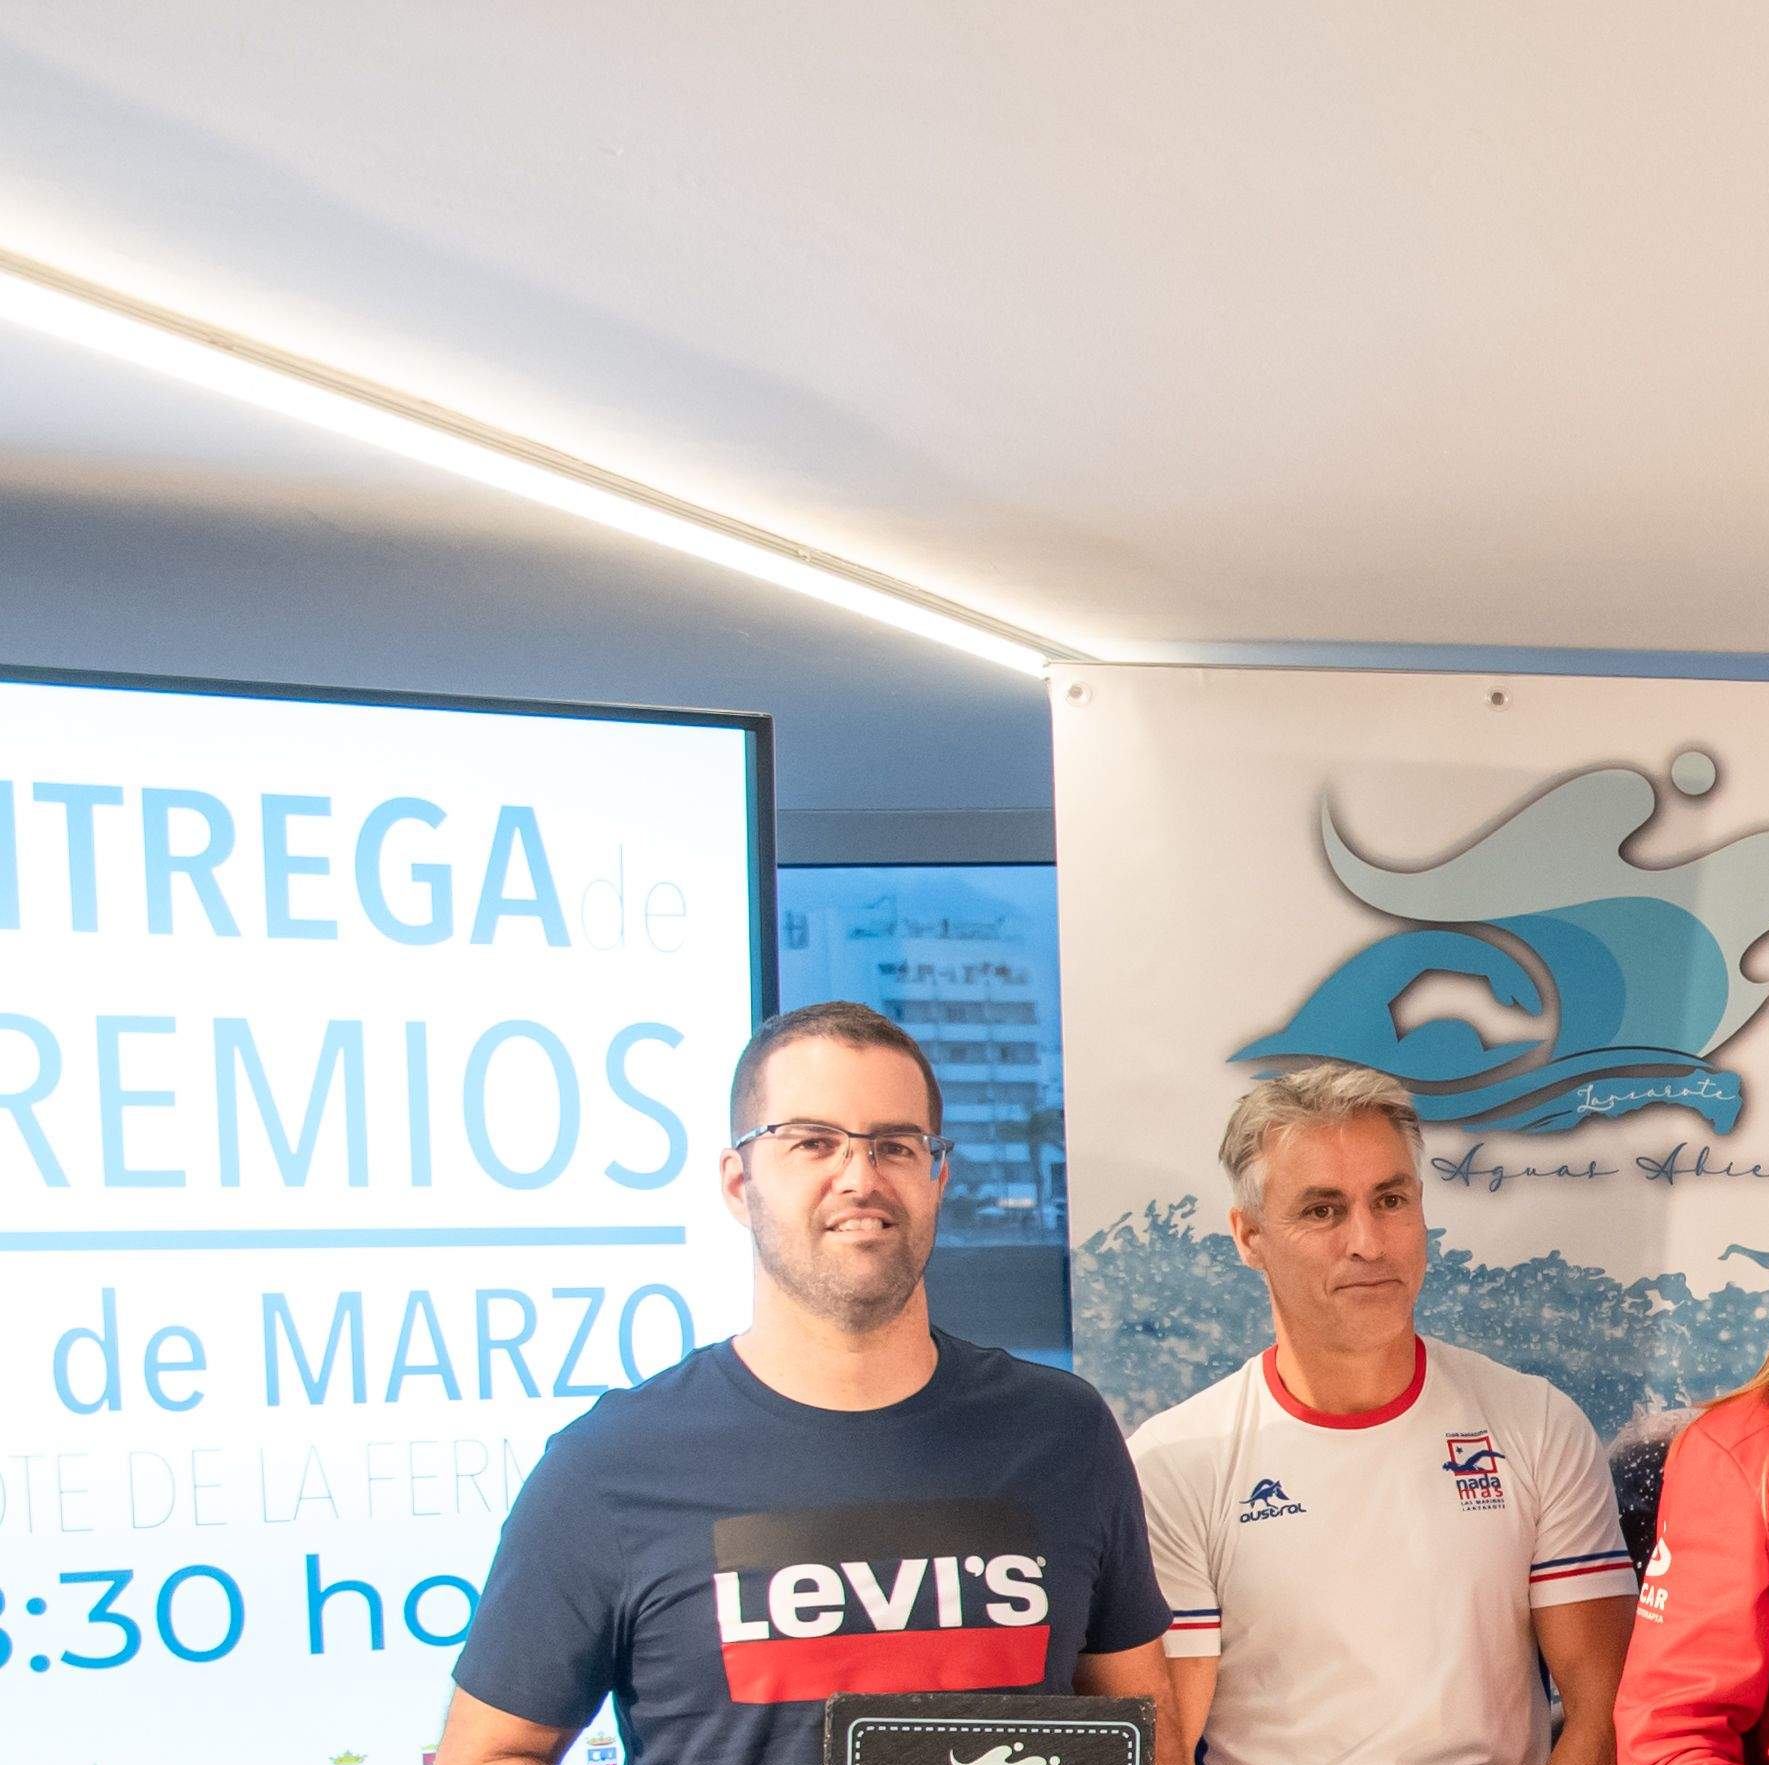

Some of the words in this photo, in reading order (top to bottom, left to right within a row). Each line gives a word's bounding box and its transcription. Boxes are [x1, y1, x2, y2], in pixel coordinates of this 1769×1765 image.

[580, 844, 687, 953] de
[1577, 1078, 1736, 1112] Lanzarote
[1431, 1143, 1619, 1192] Aguas
[53, 1287, 207, 1415] de
[261, 1283, 695, 1406] MARZO
[0, 1453, 94, 1534] TE
[129, 1449, 227, 1529] DE
[260, 1445, 340, 1523] LA
[1456, 1473, 1501, 1489] nada
[1458, 1487, 1503, 1500] mas
